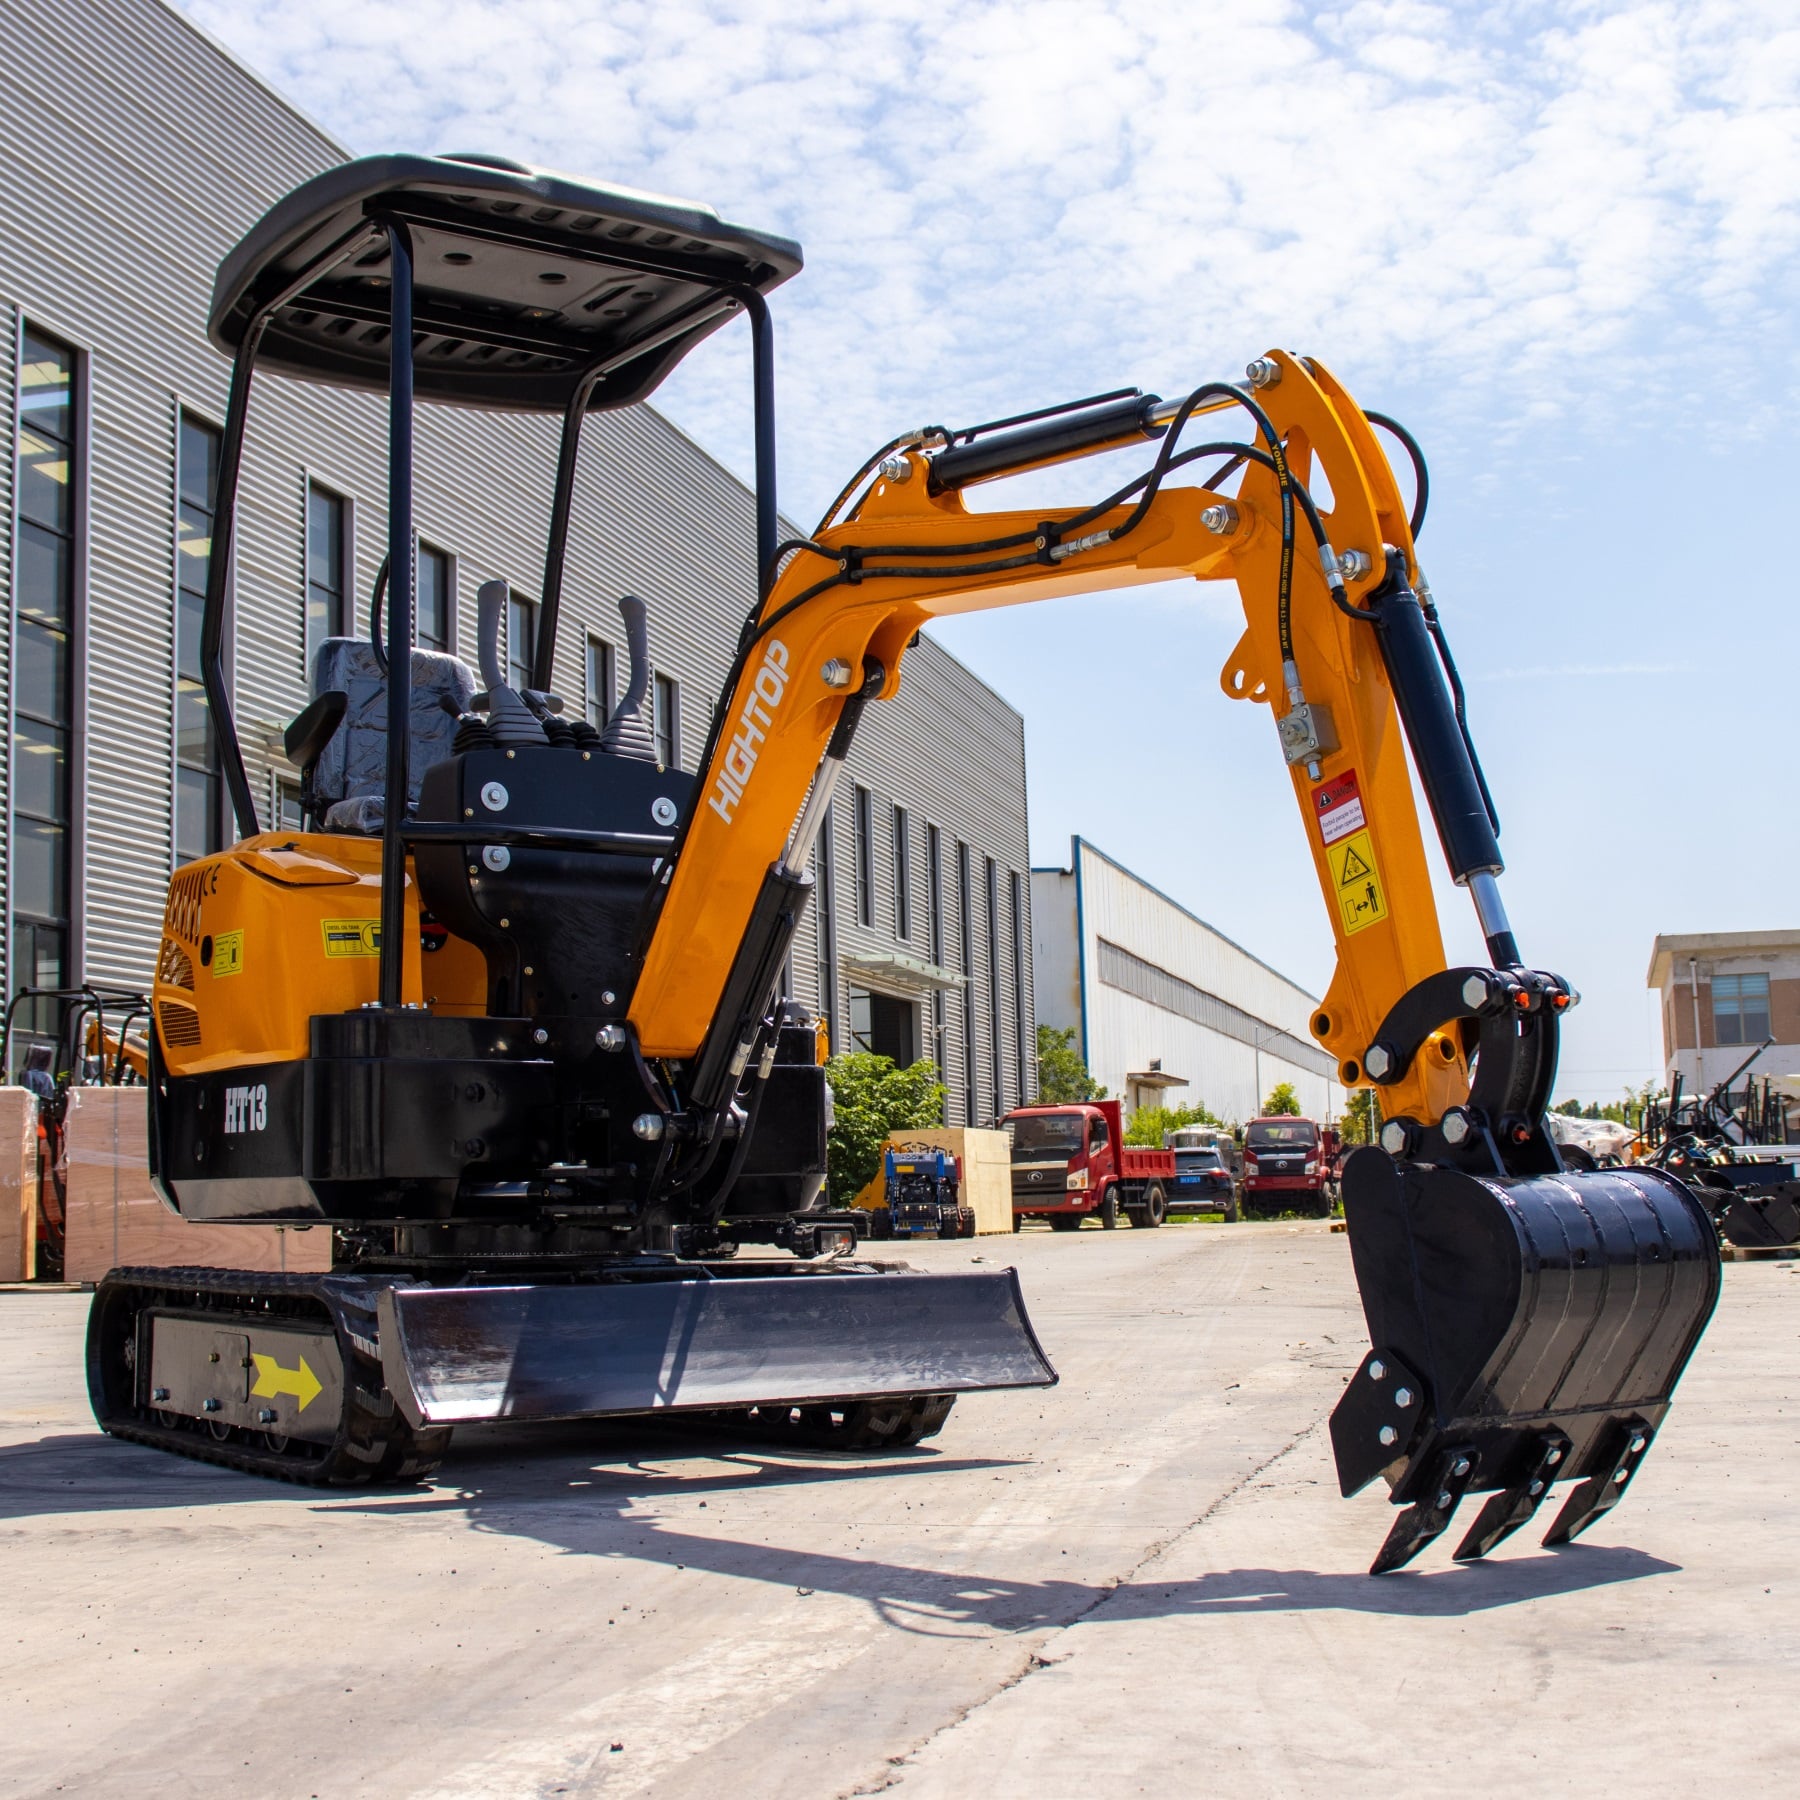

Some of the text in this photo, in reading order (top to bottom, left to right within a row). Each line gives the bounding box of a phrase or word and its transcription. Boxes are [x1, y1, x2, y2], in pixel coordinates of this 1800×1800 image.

[1271, 444, 1288, 487] YONGJIE
[708, 639, 790, 825] HIGHTOP
[1344, 815, 1362, 827] operating
[203, 863, 222, 897] CE
[224, 1083, 268, 1134] HT13
